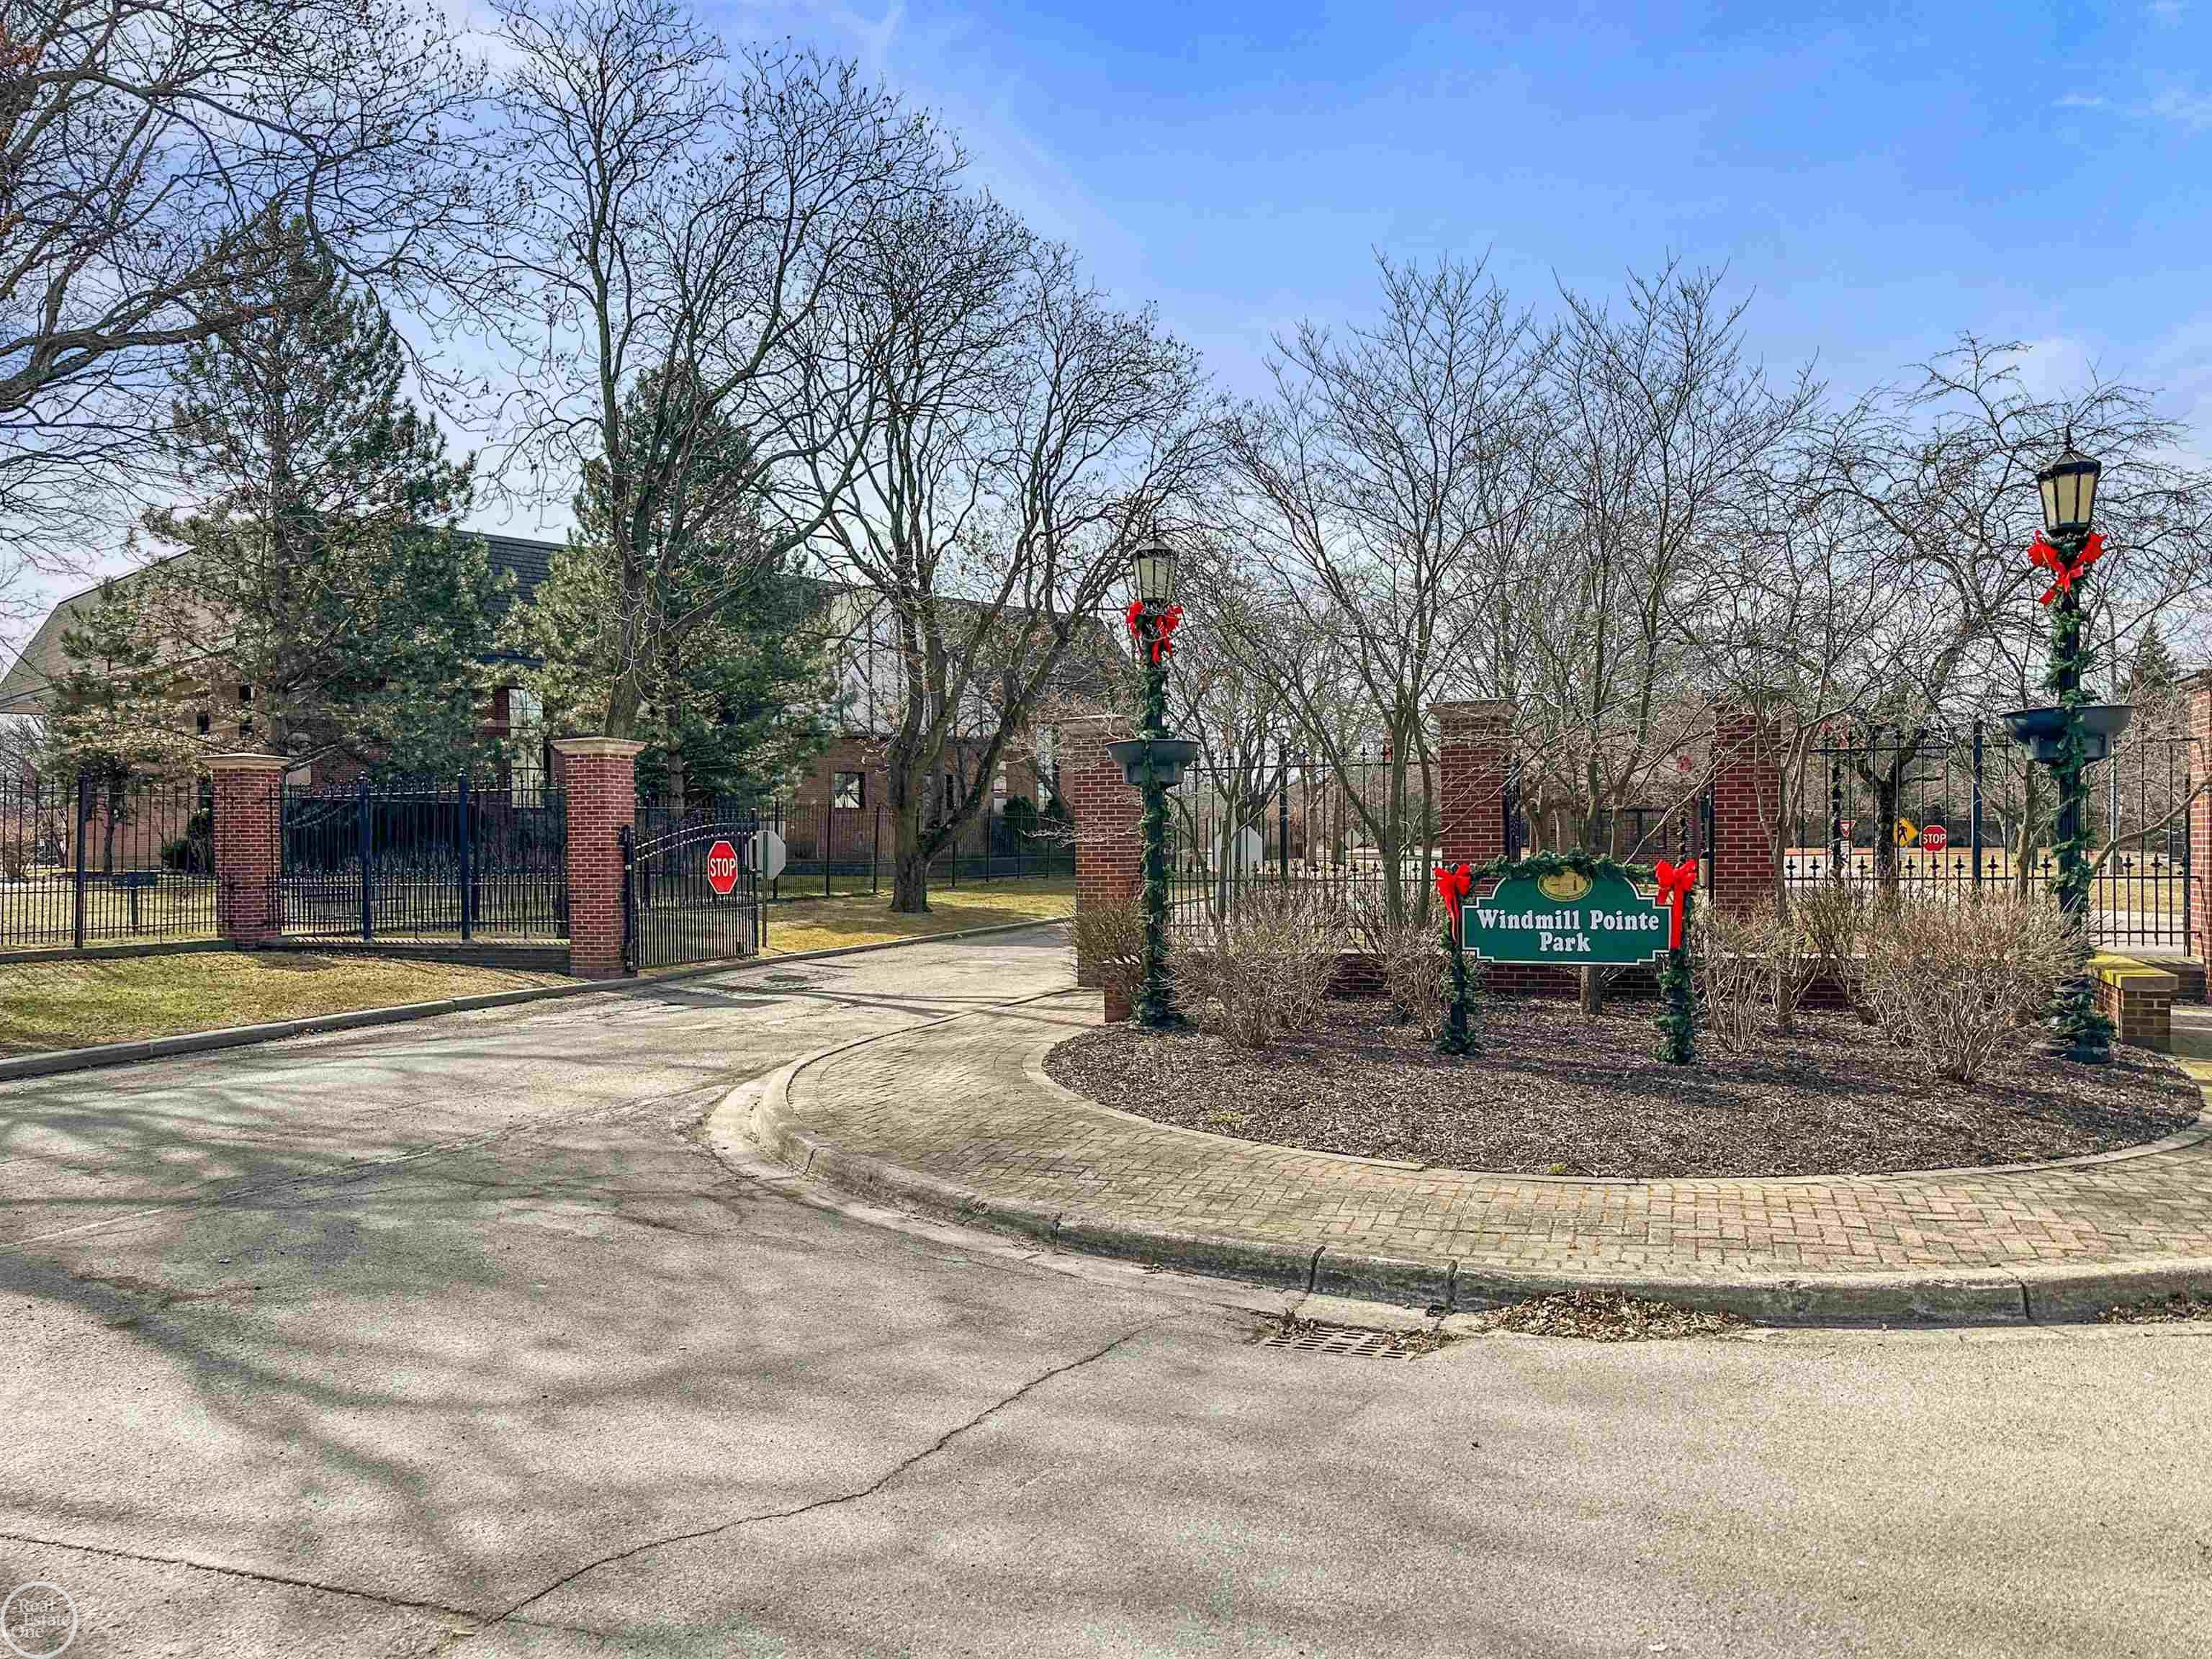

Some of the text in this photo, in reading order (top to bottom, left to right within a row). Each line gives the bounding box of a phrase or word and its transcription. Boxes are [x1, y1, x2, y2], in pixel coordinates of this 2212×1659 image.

[1923, 834, 1946, 843] STOP
[710, 858, 736, 876] STOP
[1477, 909, 1659, 931] Windmill Pointe
[1539, 932, 1591, 952] Park
